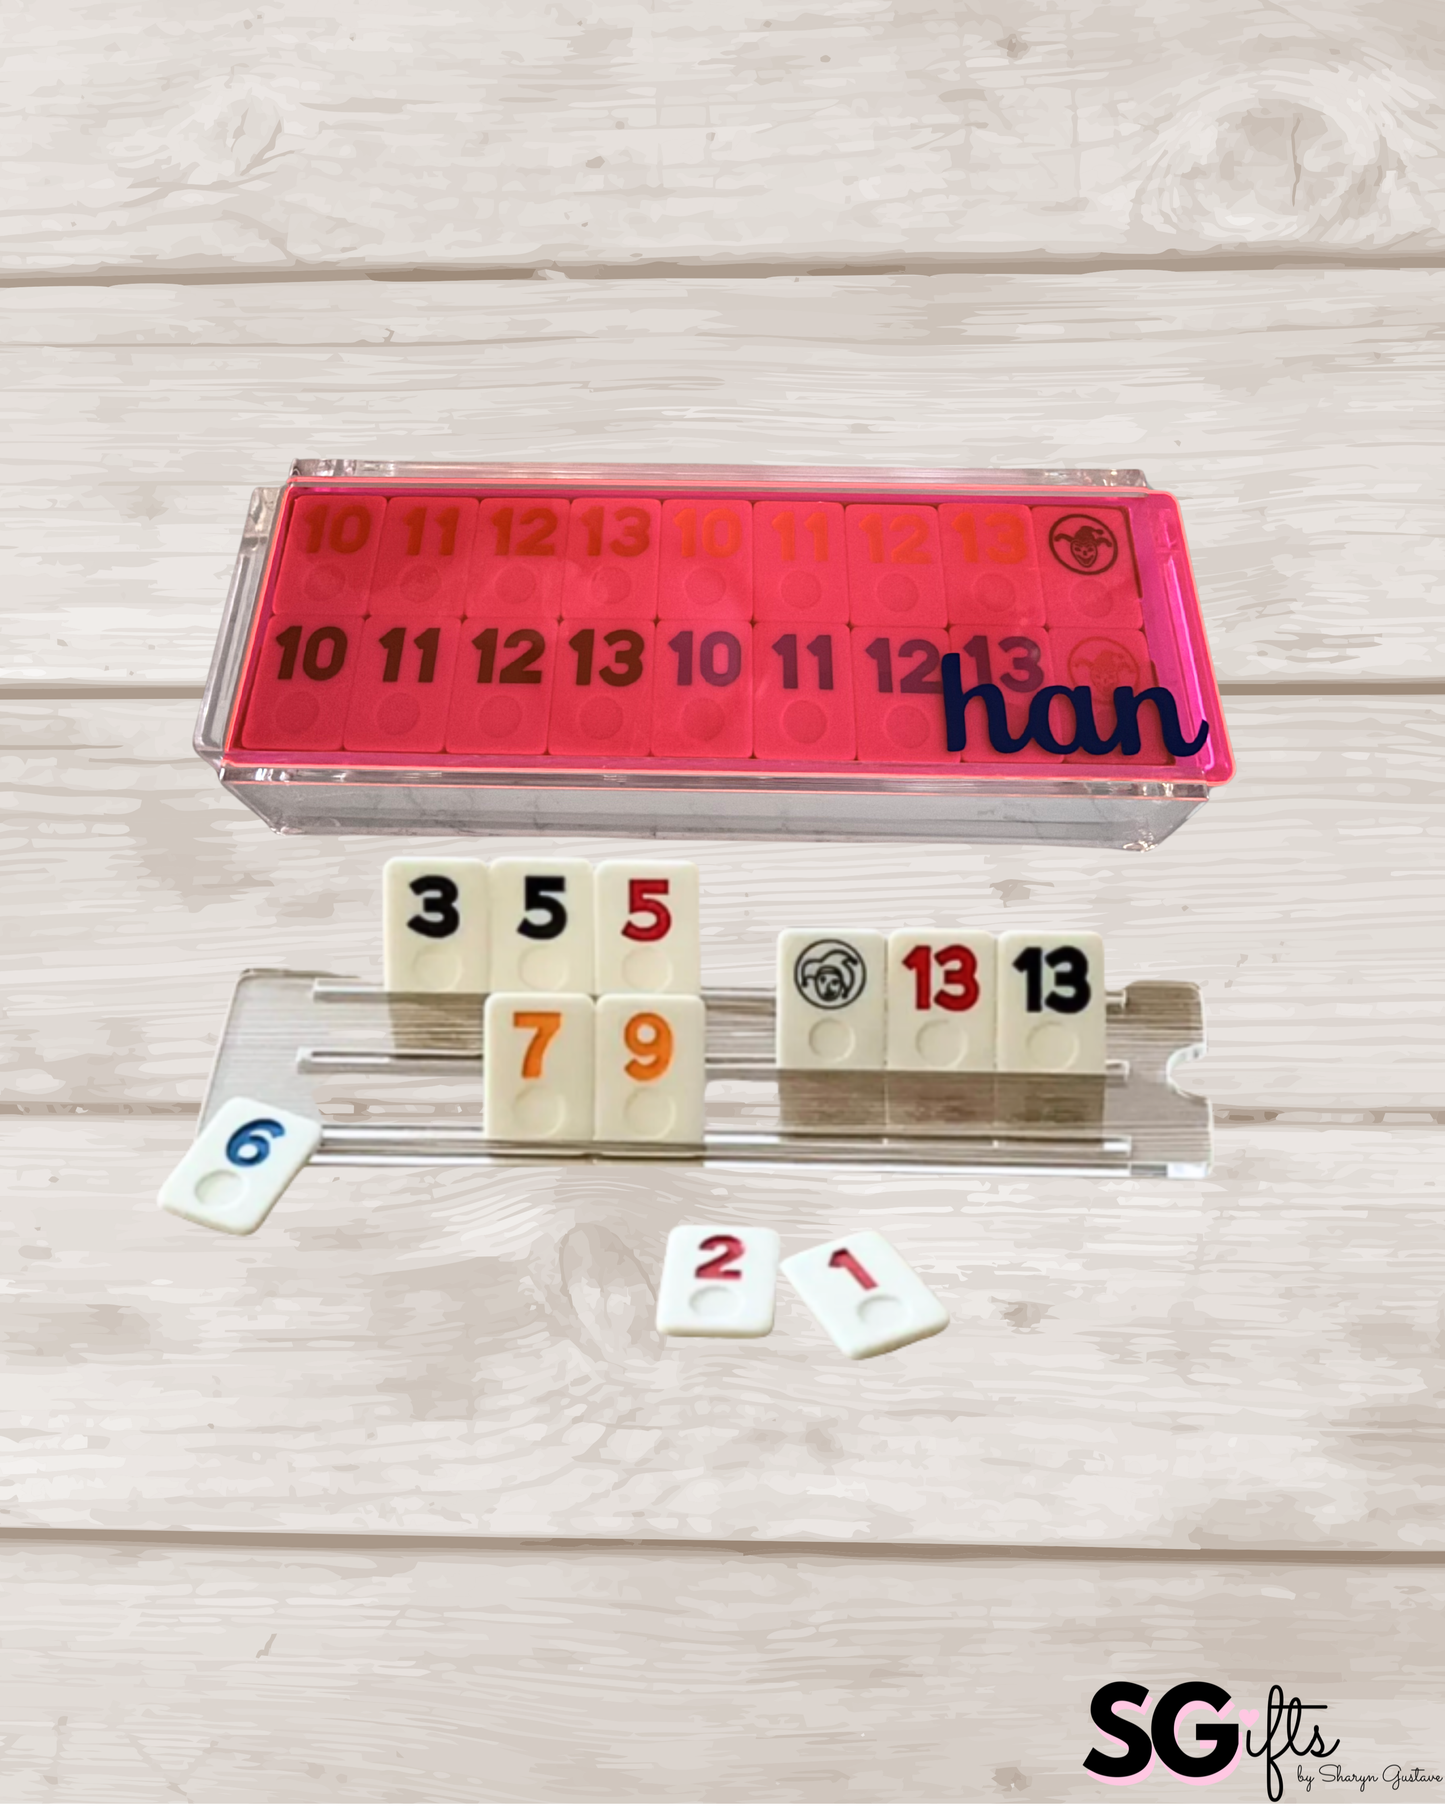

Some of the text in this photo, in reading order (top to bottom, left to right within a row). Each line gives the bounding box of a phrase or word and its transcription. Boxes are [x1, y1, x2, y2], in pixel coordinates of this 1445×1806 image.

[304, 505, 371, 554] 10
[403, 506, 460, 556] 11
[491, 506, 559, 557] 12
[580, 506, 651, 558] 13
[673, 507, 742, 558] 10
[771, 511, 829, 562] 11
[859, 512, 932, 565] 12
[951, 512, 1029, 565] 13
[275, 625, 348, 681] 10
[378, 627, 441, 683] 11
[471, 628, 546, 684] 12
[568, 628, 645, 687] 13
[668, 630, 742, 687] 10
[771, 633, 834, 690] 11
[865, 637, 944, 695] 12
[962, 635, 1045, 694] 13
[940, 652, 1210, 758] han
[406, 874, 460, 939] 3
[516, 875, 568, 941] 5
[620, 878, 673, 943] 5
[901, 944, 980, 1012] 13
[1012, 945, 1092, 1014] 13
[512, 1011, 562, 1079] 7
[623, 1011, 674, 1082] 9
[225, 1117, 286, 1167] 6
[694, 1234, 745, 1280] 2
[828, 1247, 879, 1291] 1
